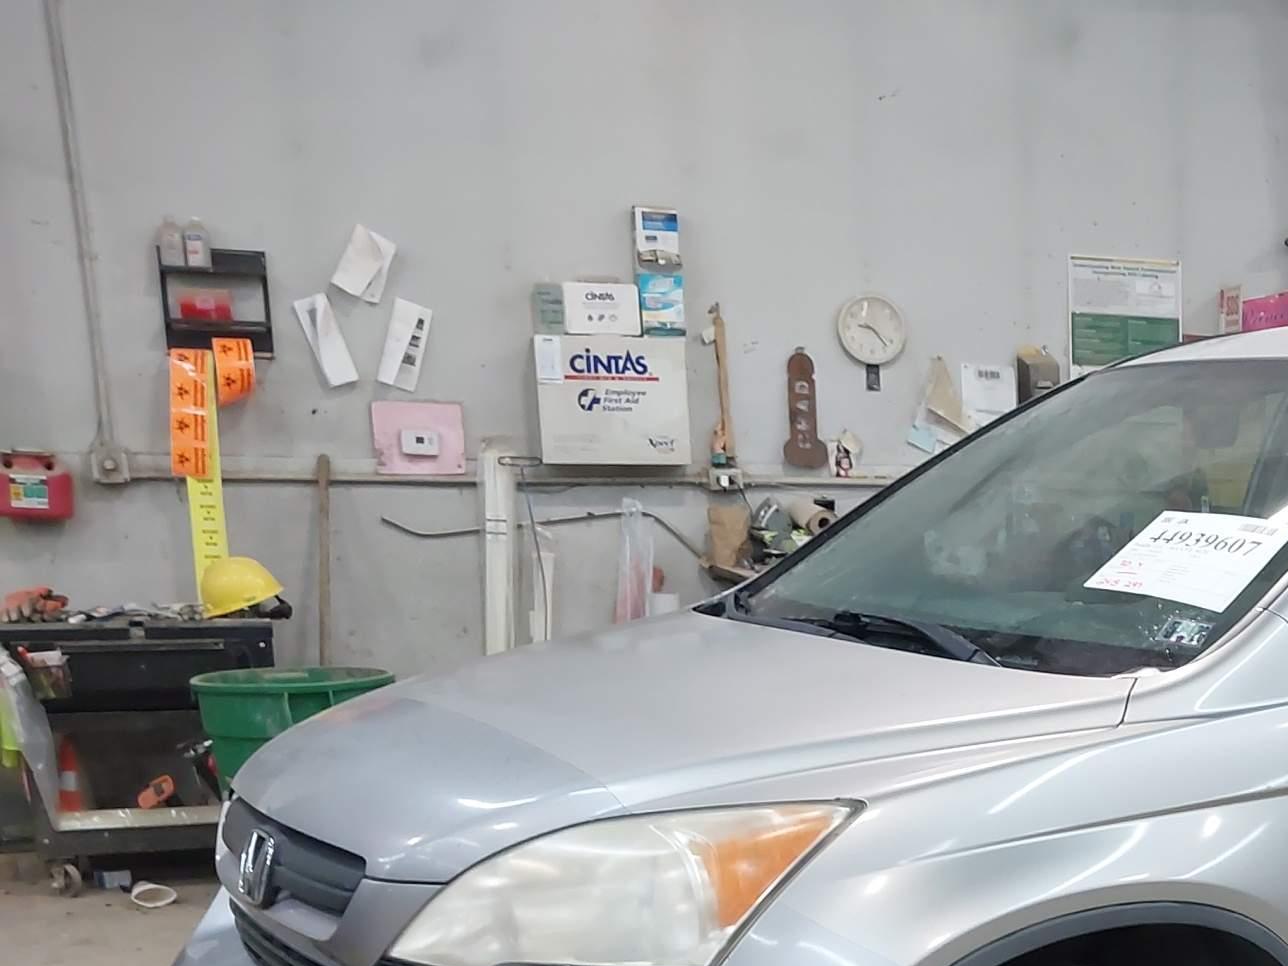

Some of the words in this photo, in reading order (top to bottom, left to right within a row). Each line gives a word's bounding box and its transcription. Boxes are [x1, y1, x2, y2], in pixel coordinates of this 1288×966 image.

[604, 388, 647, 397] Employee
[603, 397, 622, 405] First
[624, 397, 640, 405] Aid
[1149, 528, 1263, 557] 44939607
